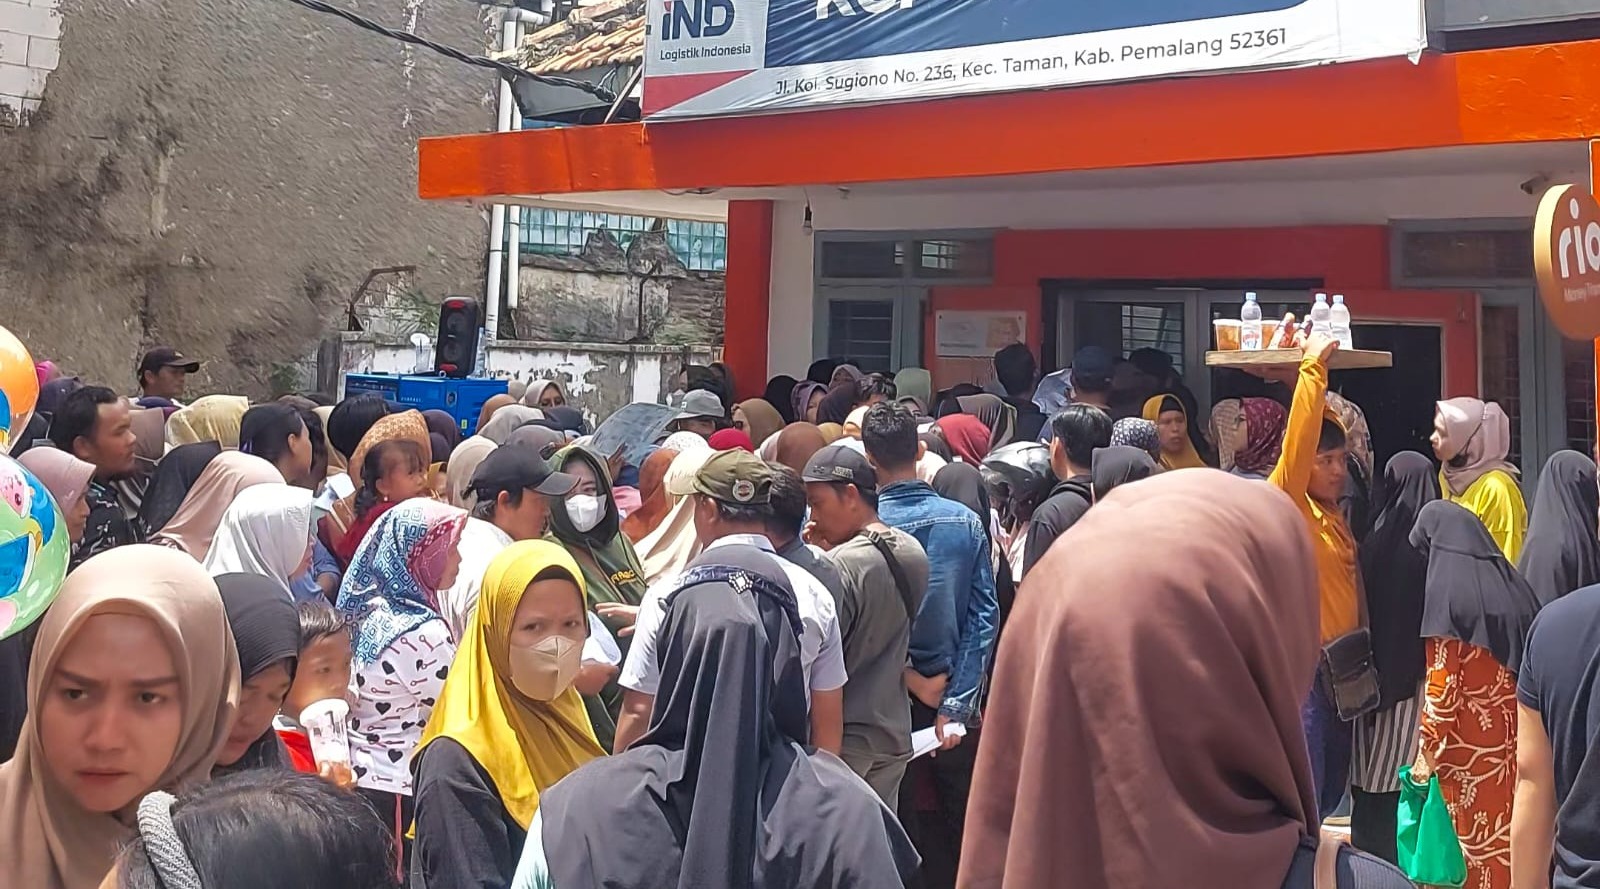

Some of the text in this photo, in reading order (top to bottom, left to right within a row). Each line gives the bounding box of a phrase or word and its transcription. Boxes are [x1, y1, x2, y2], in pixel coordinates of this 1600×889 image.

[660, 43, 751, 62] Logistik Indonesia
[776, 79, 790, 94] Jl.
[825, 72, 888, 92] Sugiono
[894, 68, 919, 84] No.
[924, 64, 957, 82] 236,
[962, 61, 997, 78] Kec.
[1003, 56, 1068, 73] Taman,
[1074, 47, 1115, 66] Kab.
[1121, 39, 1223, 61] Pemalang
[1230, 28, 1286, 50] 52361
